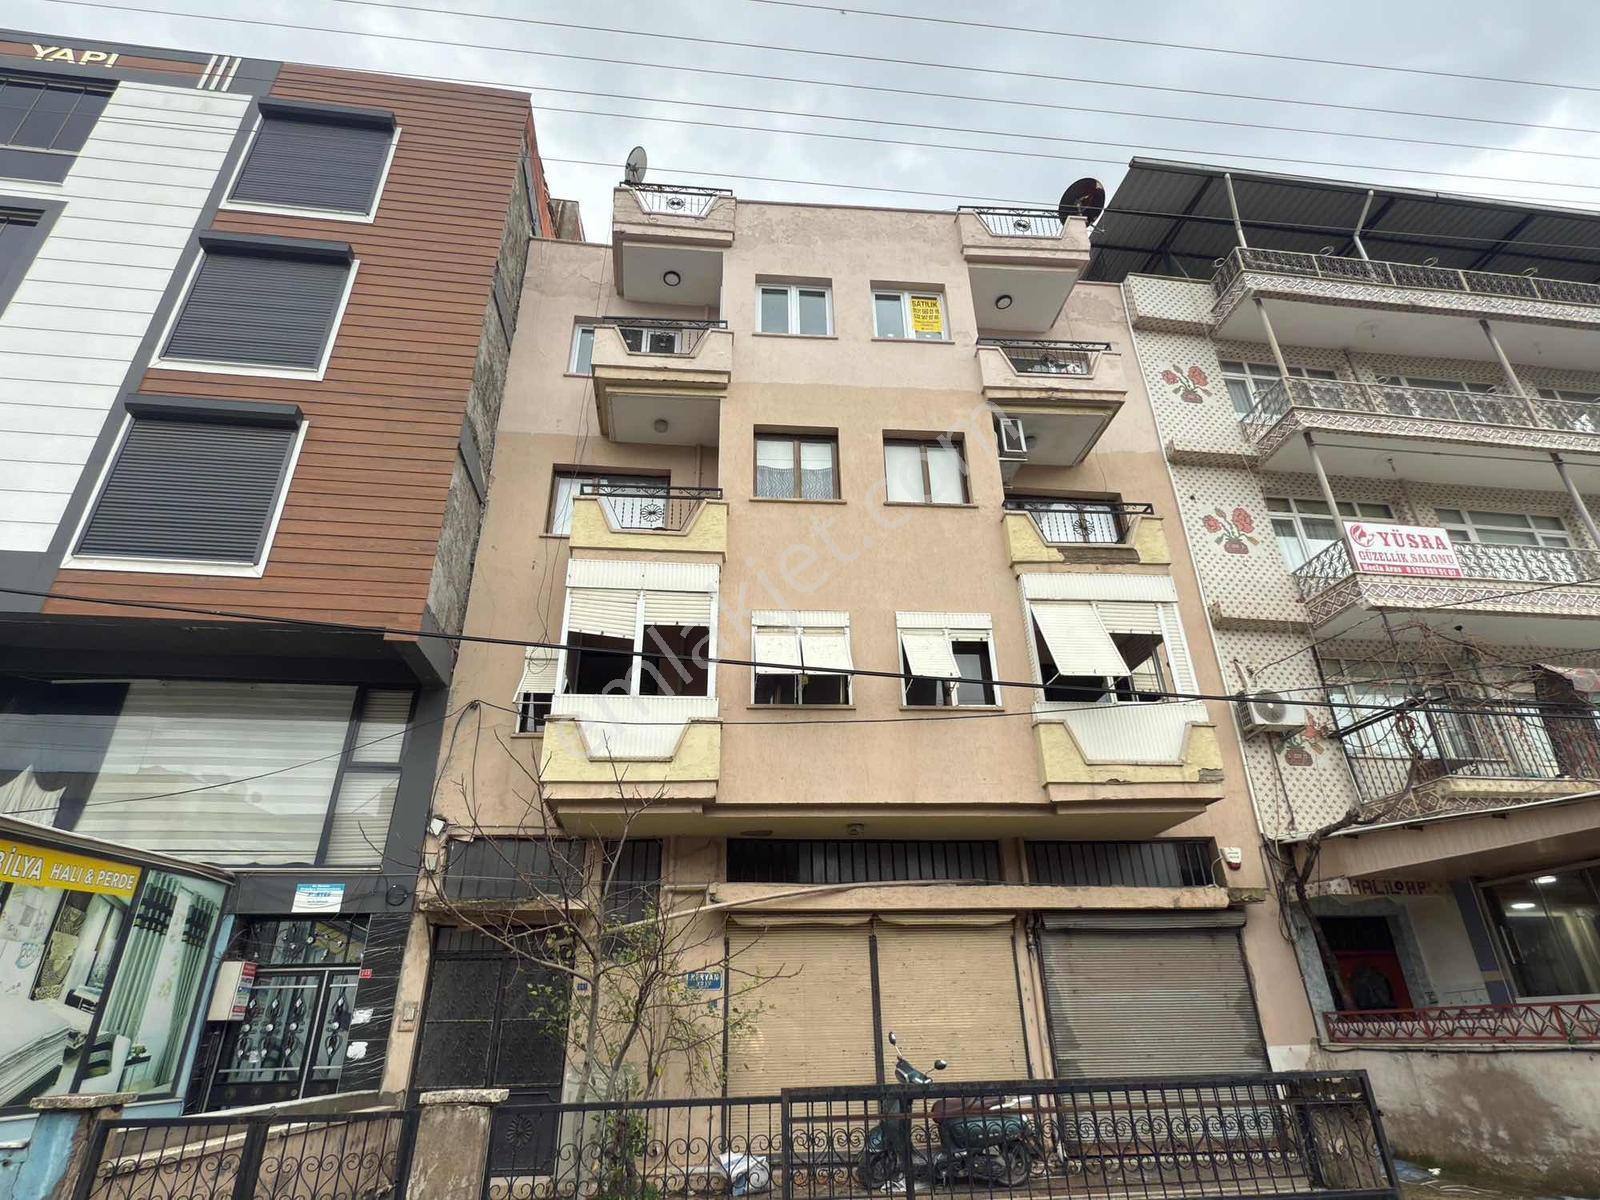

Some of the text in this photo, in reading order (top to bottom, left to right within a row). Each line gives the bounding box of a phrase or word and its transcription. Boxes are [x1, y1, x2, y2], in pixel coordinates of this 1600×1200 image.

[31, 44, 119, 68] YAPI
[911, 300, 938, 308] SATILIK
[1376, 529, 1449, 550] YÜSRA
[1358, 549, 1455, 564] GÜZELLİK SALONU
[49, 863, 83, 882] HALI
[84, 869, 95, 885] &
[95, 869, 136, 889] PERDE
